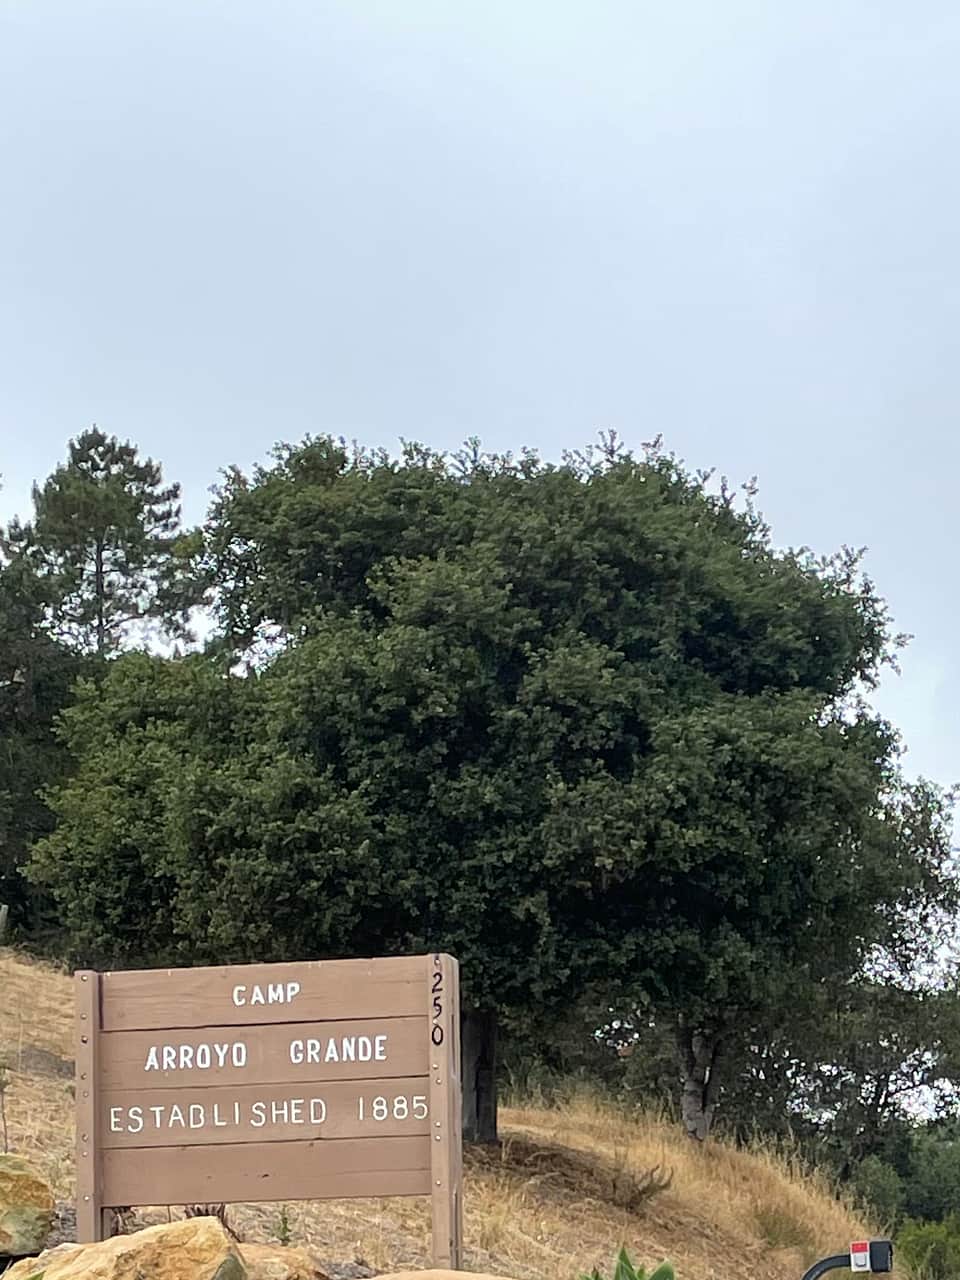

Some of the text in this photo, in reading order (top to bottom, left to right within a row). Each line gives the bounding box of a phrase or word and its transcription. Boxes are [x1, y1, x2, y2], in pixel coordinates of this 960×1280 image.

[233, 982, 301, 1007] CAMP
[431, 971, 444, 1046] 250
[144, 1036, 388, 1072] ARROYO GRANDE
[109, 1096, 429, 1133] ESTABLISHED 1885
